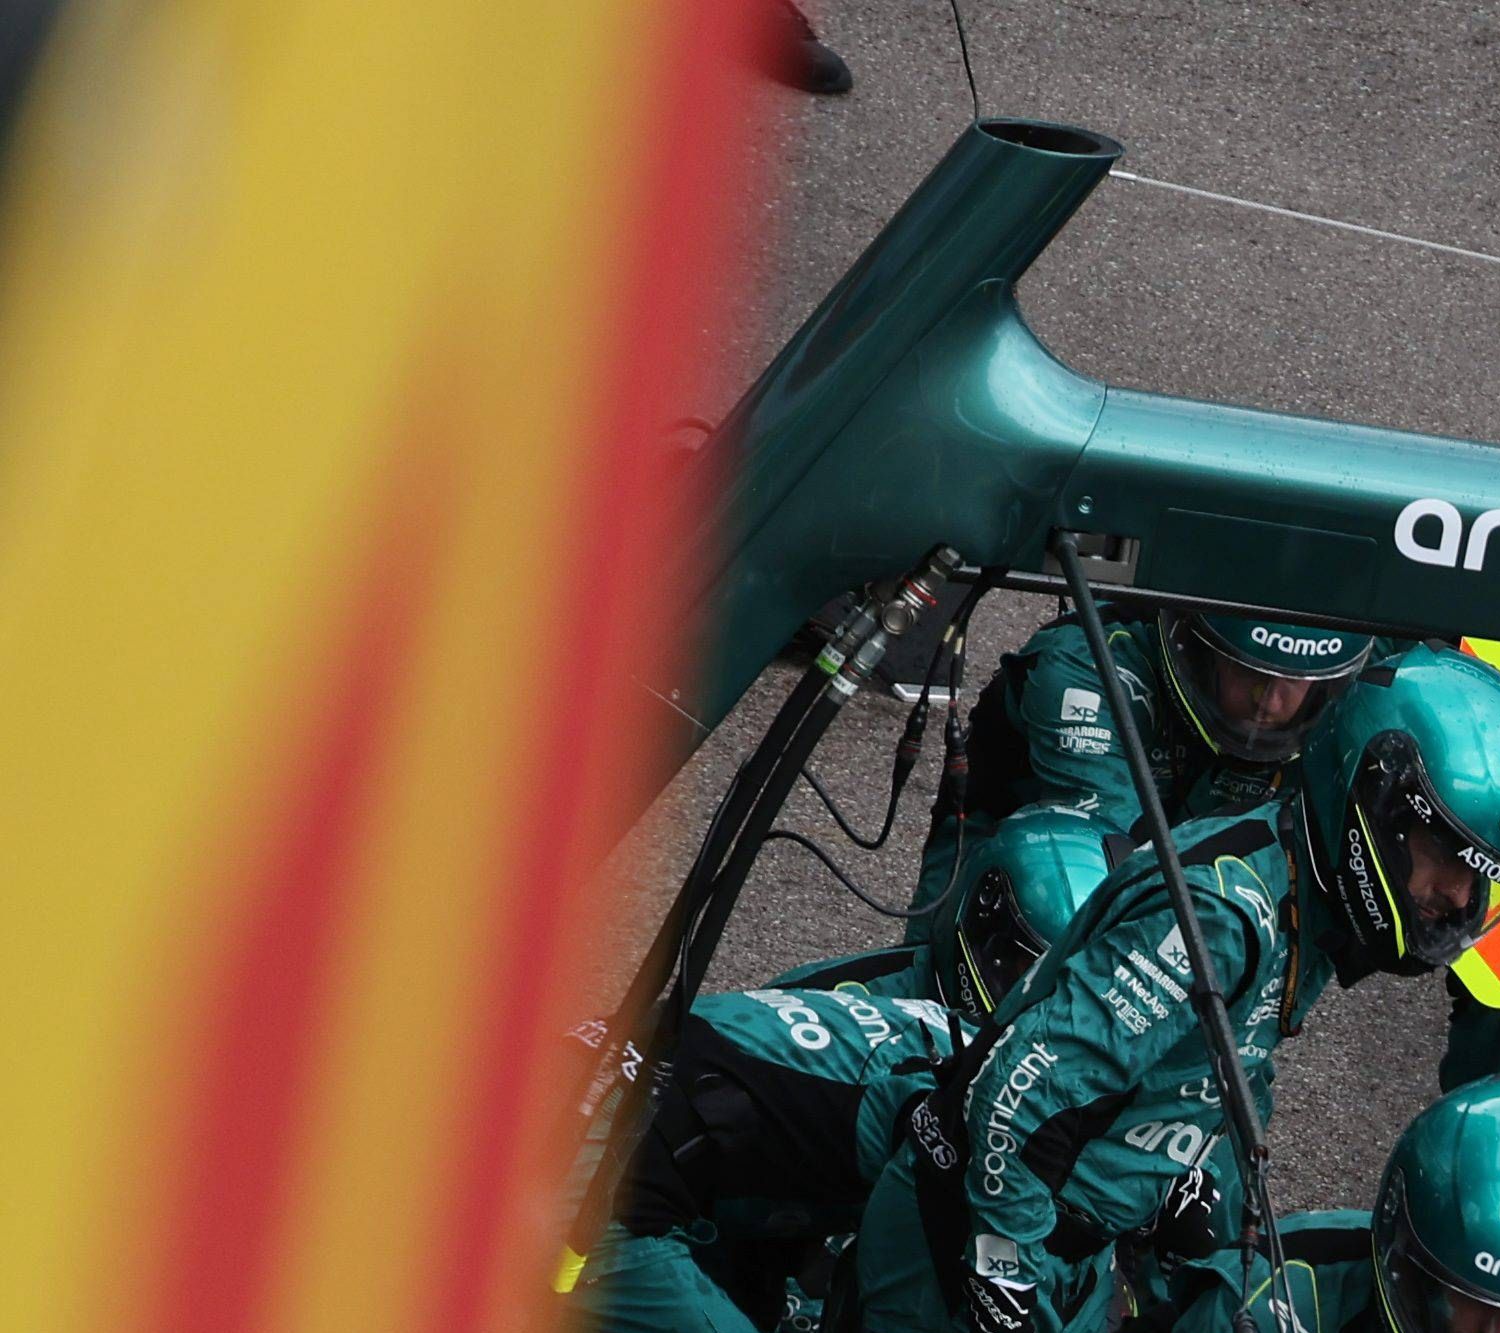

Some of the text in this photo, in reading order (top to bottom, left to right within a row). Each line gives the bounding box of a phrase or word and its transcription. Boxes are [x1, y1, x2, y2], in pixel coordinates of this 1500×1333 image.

[1250, 626, 1343, 656] aramco
[1348, 828, 1390, 932] cognizant
[1125, 974, 1170, 1021] NetApp
[1127, 949, 1189, 1004] BOMBARDIER
[984, 1042, 1059, 1196] cognizant
